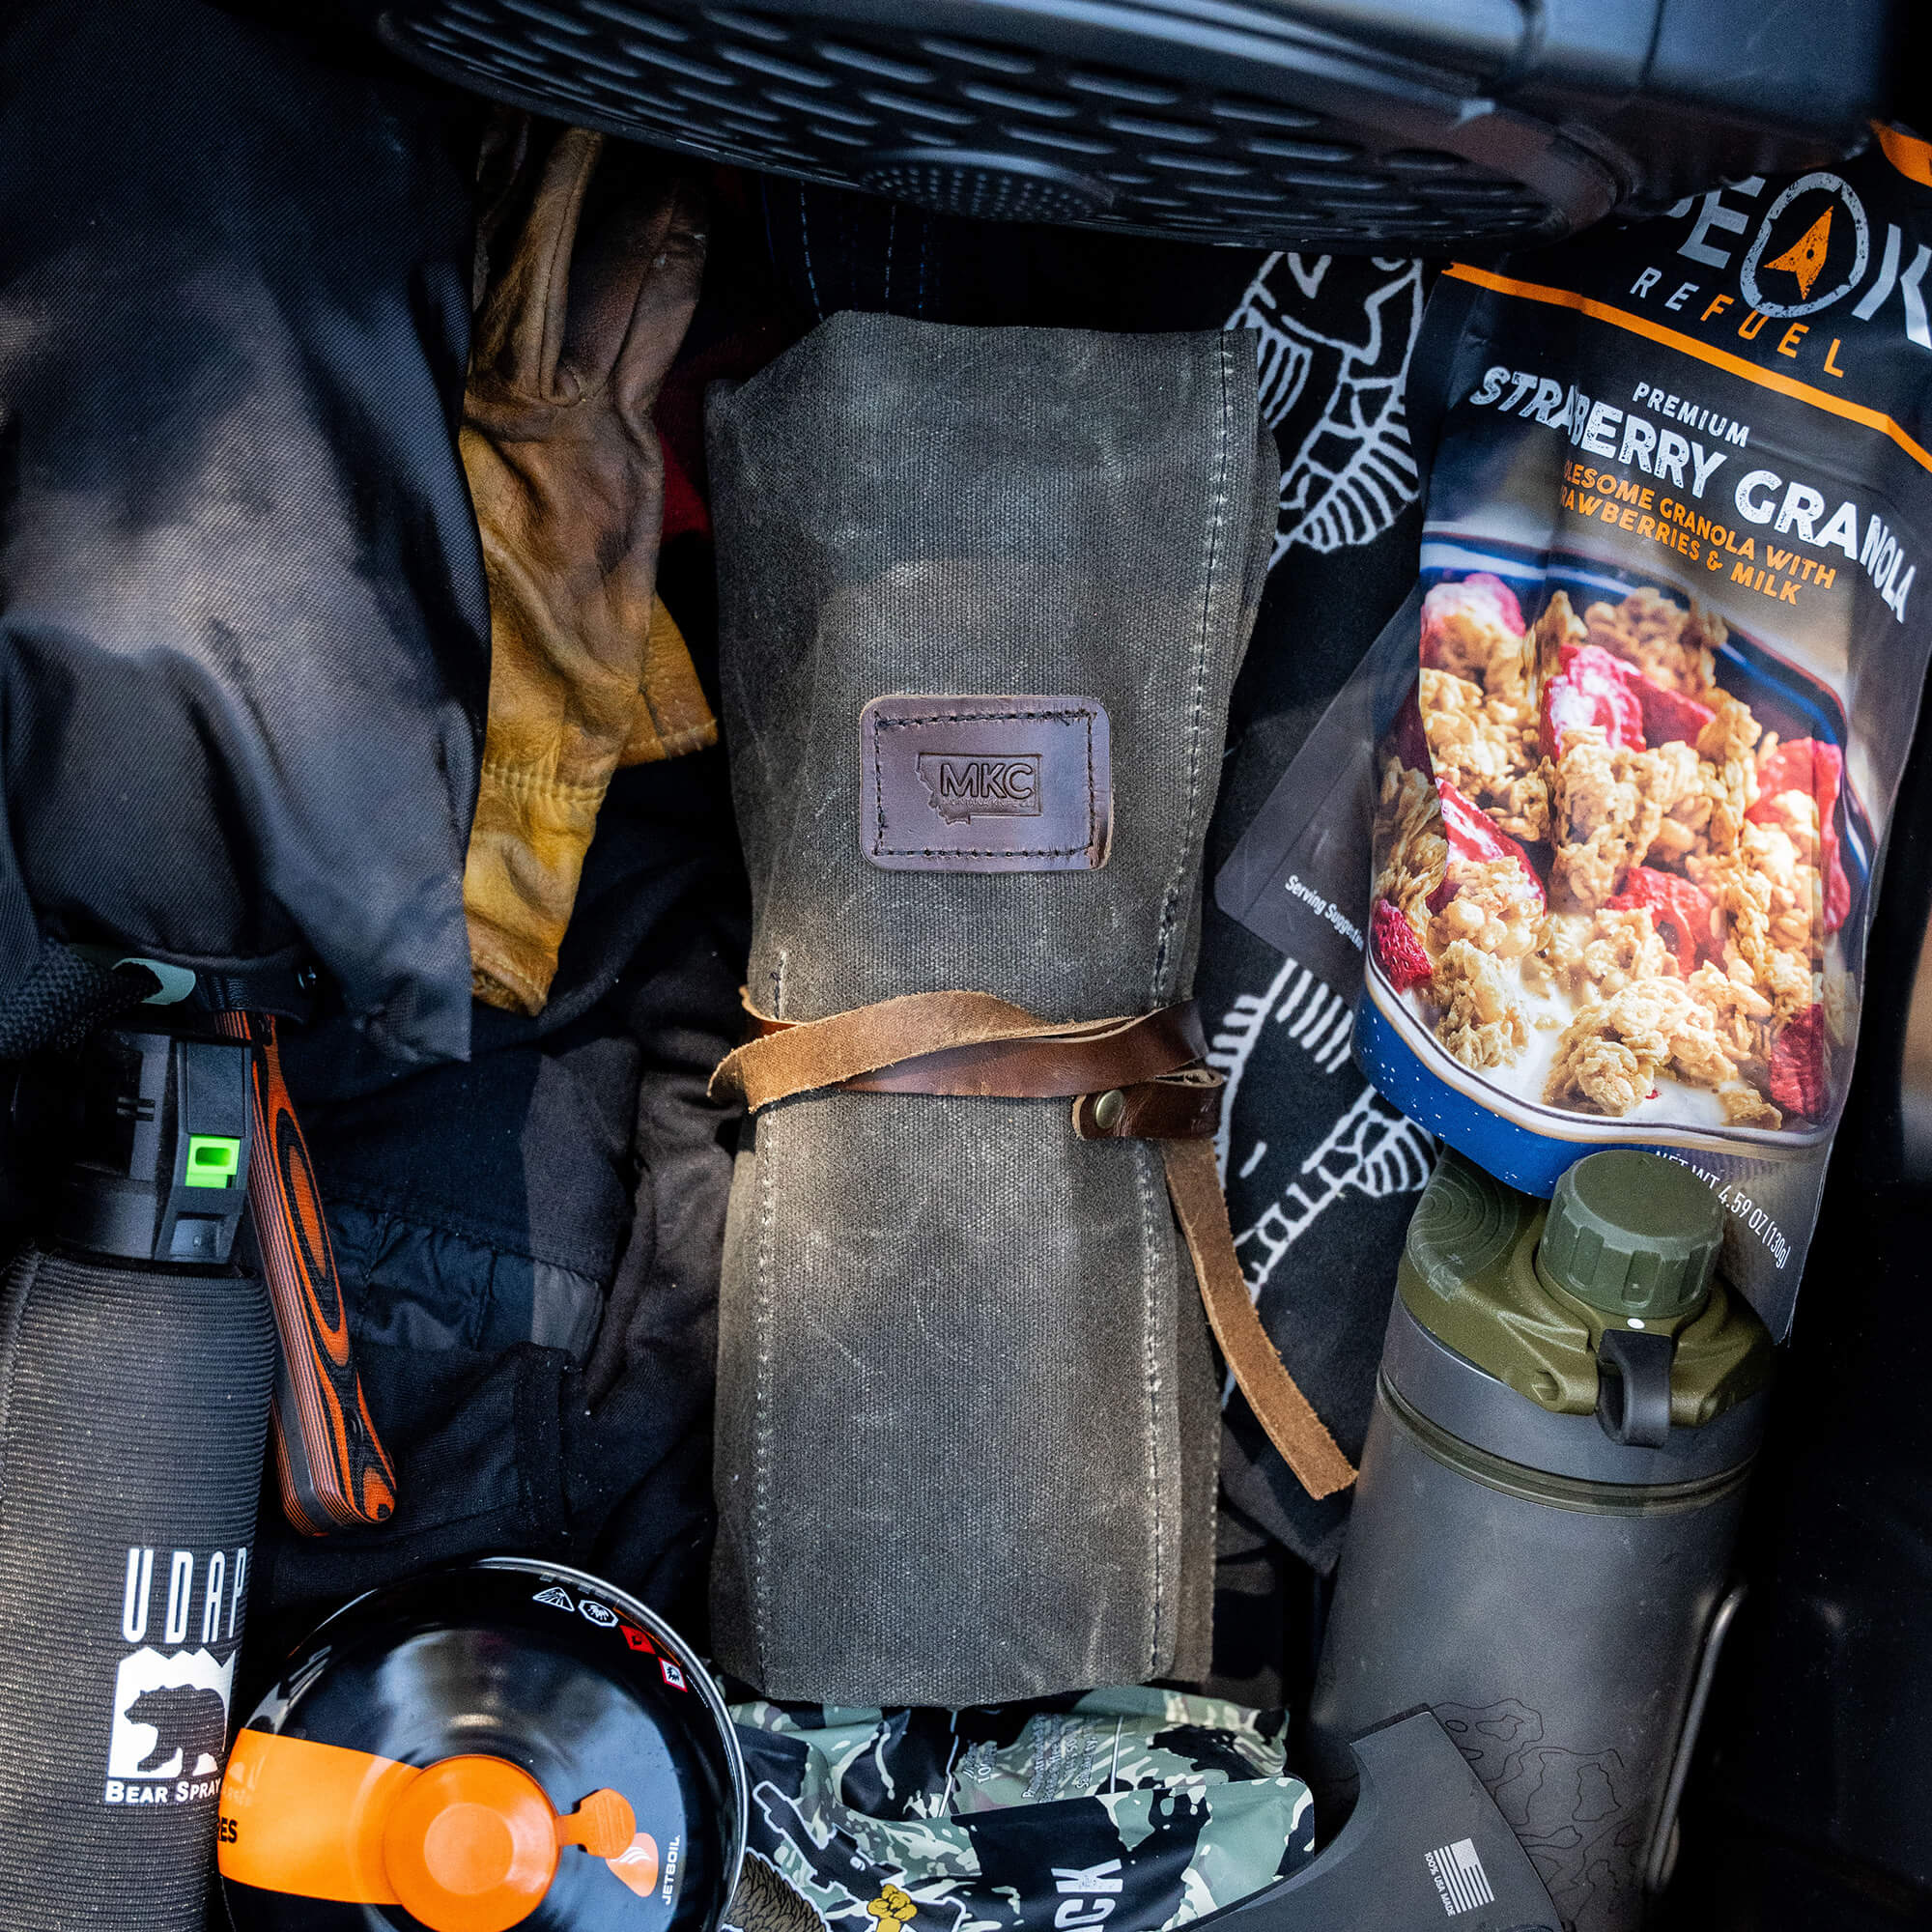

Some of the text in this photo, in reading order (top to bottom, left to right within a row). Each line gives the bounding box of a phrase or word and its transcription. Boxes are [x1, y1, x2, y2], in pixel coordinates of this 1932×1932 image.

[1630, 267, 1844, 379] REFUEL
[1633, 382, 1749, 447] PREMIUM
[1660, 497, 1754, 560] GRANOLA
[1766, 545, 1836, 589] WITH
[1706, 551, 1723, 571] &
[1730, 561, 1803, 606] MILK
[1735, 469, 1917, 624] GRANOLA
[940, 762, 1034, 799] MKC
[1285, 874, 1327, 916] Serving
[1718, 1185, 1752, 1218] 4.59
[1748, 1208, 1769, 1236] OZ
[1762, 1221, 1791, 1269] (130g)
[123, 1547, 246, 1643] UDAP
[105, 1780, 168, 1803] BEAR
[662, 1834, 681, 1905] JETBOIL
[1050, 1858, 1123, 1932] CK
[1424, 1851, 1456, 1917] 100% USA MADE
